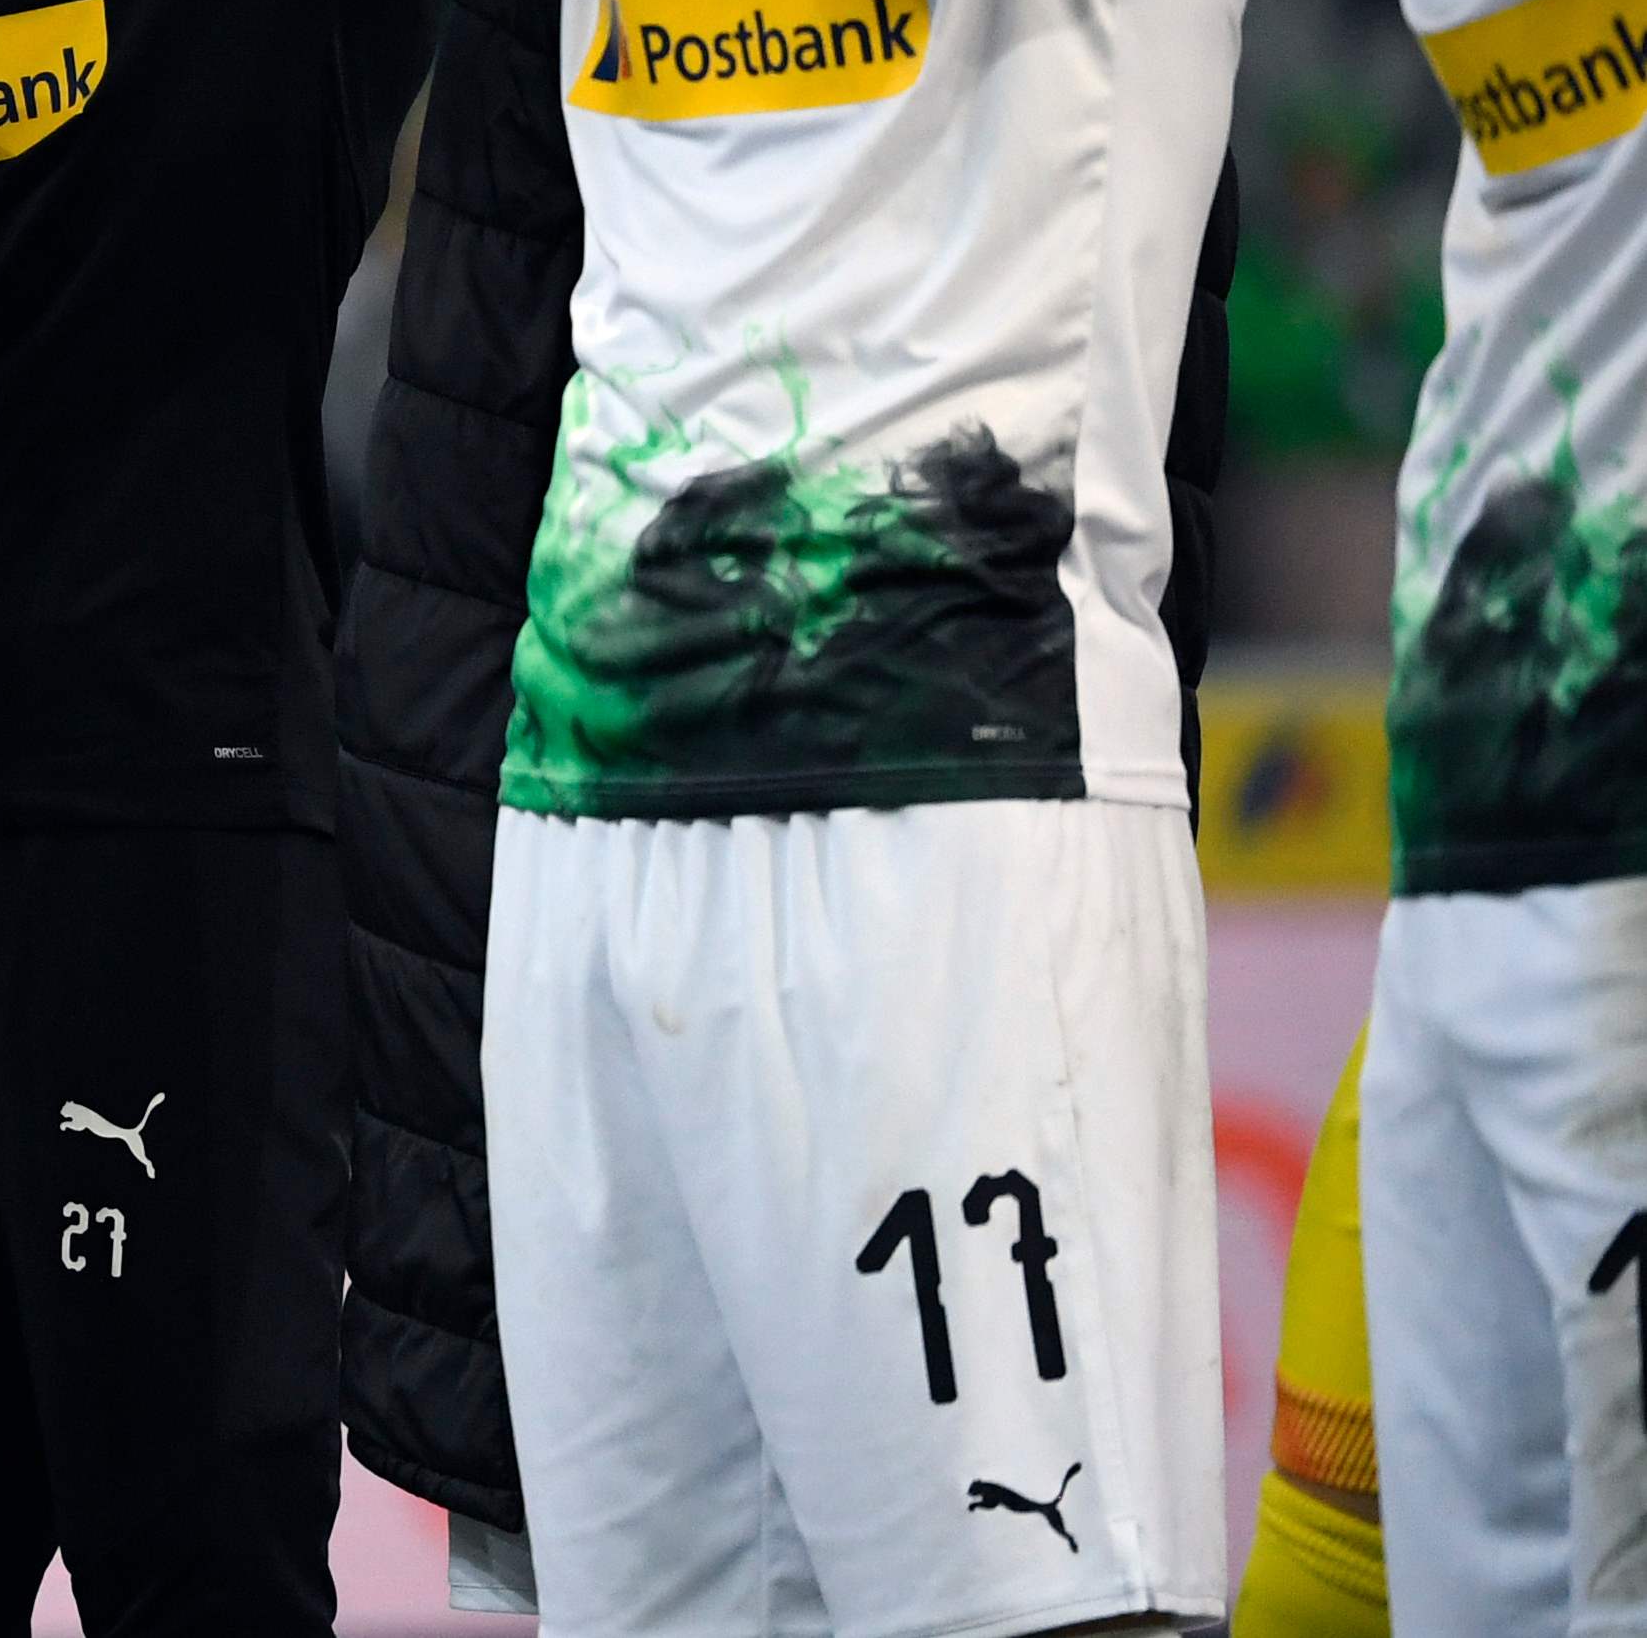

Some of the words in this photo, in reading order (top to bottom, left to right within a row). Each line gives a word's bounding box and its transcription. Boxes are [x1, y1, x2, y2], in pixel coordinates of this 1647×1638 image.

[213, 746, 264, 759] DRYCELL
[61, 1201, 128, 1278] 27
[855, 1168, 1067, 1405] 17
